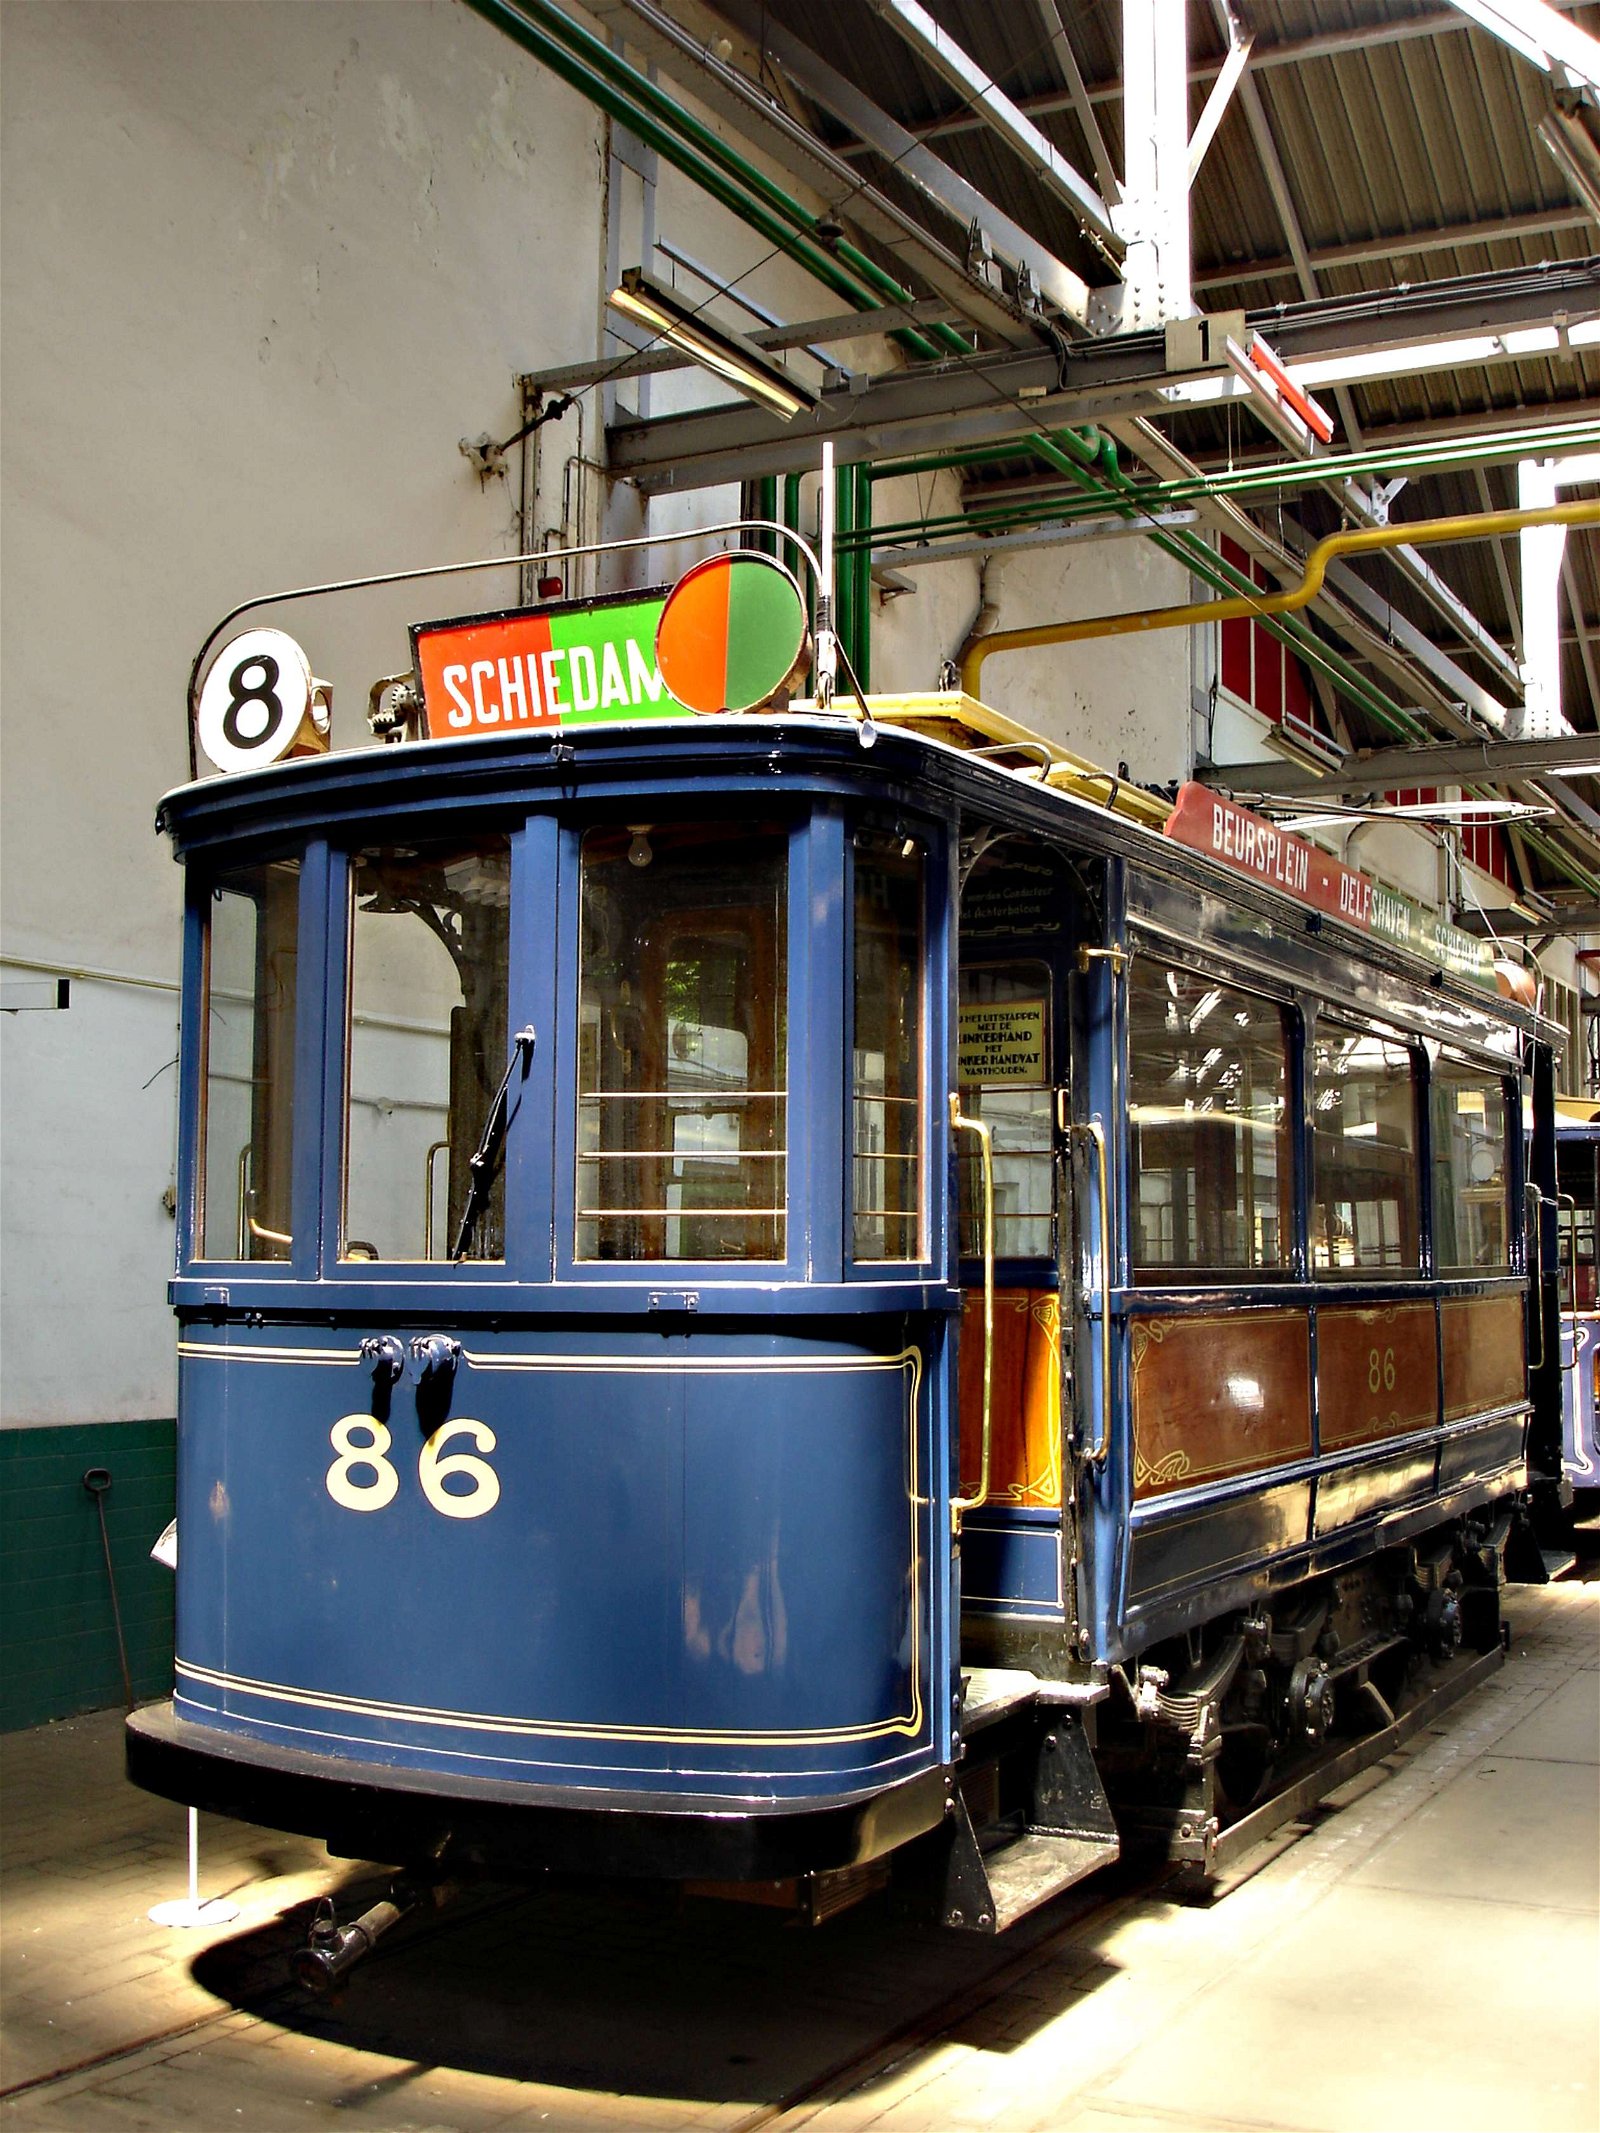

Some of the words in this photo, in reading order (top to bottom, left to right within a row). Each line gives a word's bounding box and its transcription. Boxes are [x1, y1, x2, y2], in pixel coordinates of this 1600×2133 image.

[1198, 319, 1210, 362] 1
[223, 654, 283, 749] 8
[442, 638, 674, 728] SCHIEDAM
[1212, 803, 1309, 893] BEURSPLEIN
[1340, 872, 1411, 943] DELFSHAVEN
[977, 1023, 996, 1031] MET
[999, 1022, 1013, 1030] DE
[983, 1011, 1040, 1022] UITSTAPPEN
[990, 1053, 1040, 1065] HANDVAT
[1368, 1347, 1396, 1394] 86
[325, 1413, 501, 1519] 86
